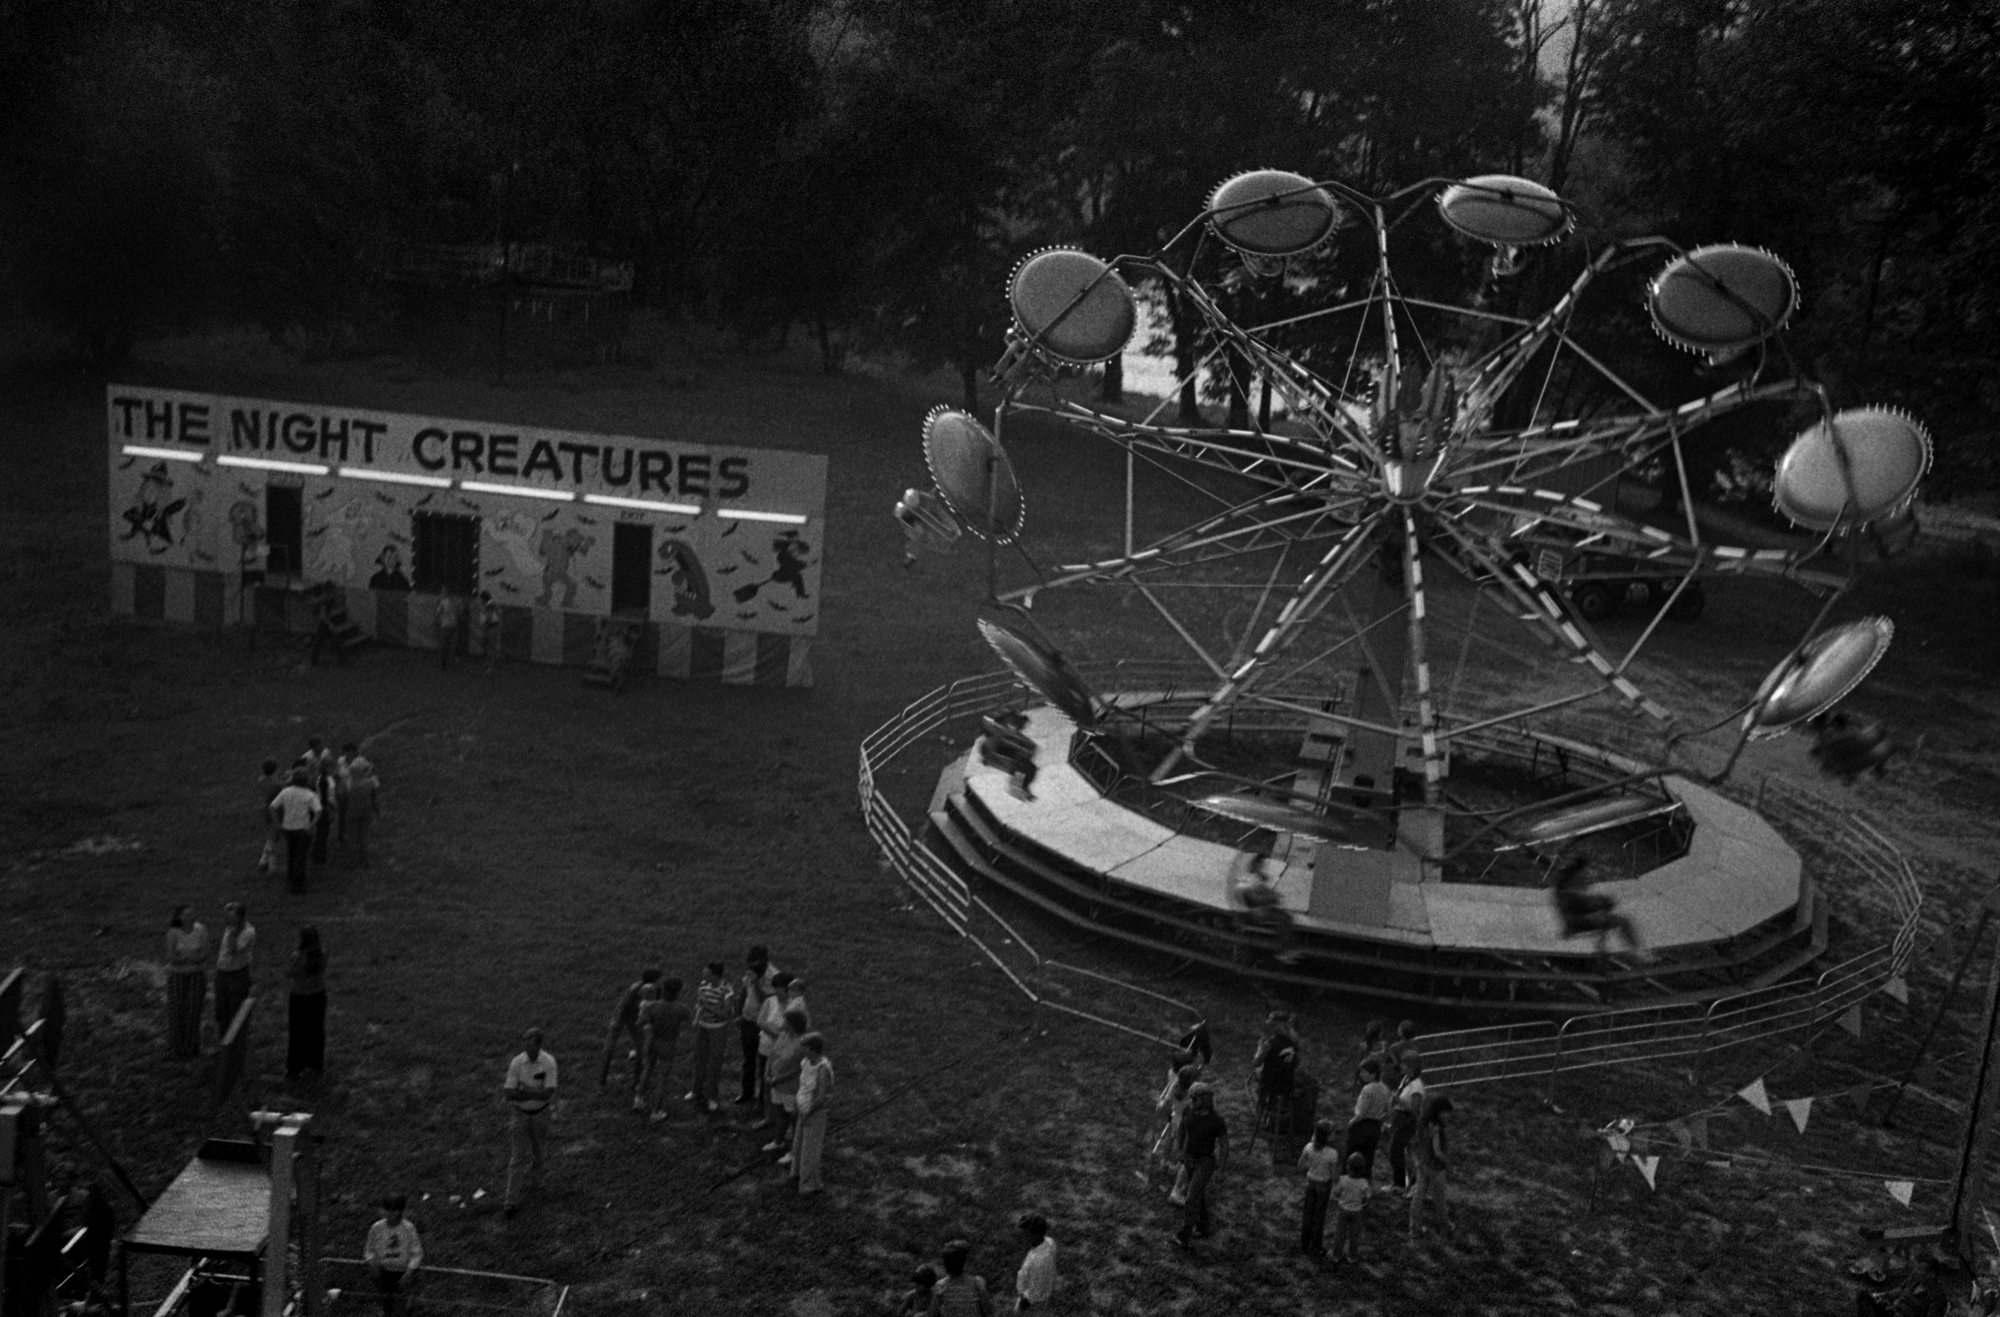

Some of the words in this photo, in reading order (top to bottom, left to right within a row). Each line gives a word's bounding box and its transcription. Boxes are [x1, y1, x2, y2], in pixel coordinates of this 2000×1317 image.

[113, 396, 210, 444] THE
[231, 409, 387, 463] NIGHT
[412, 428, 750, 499] CREATURES
